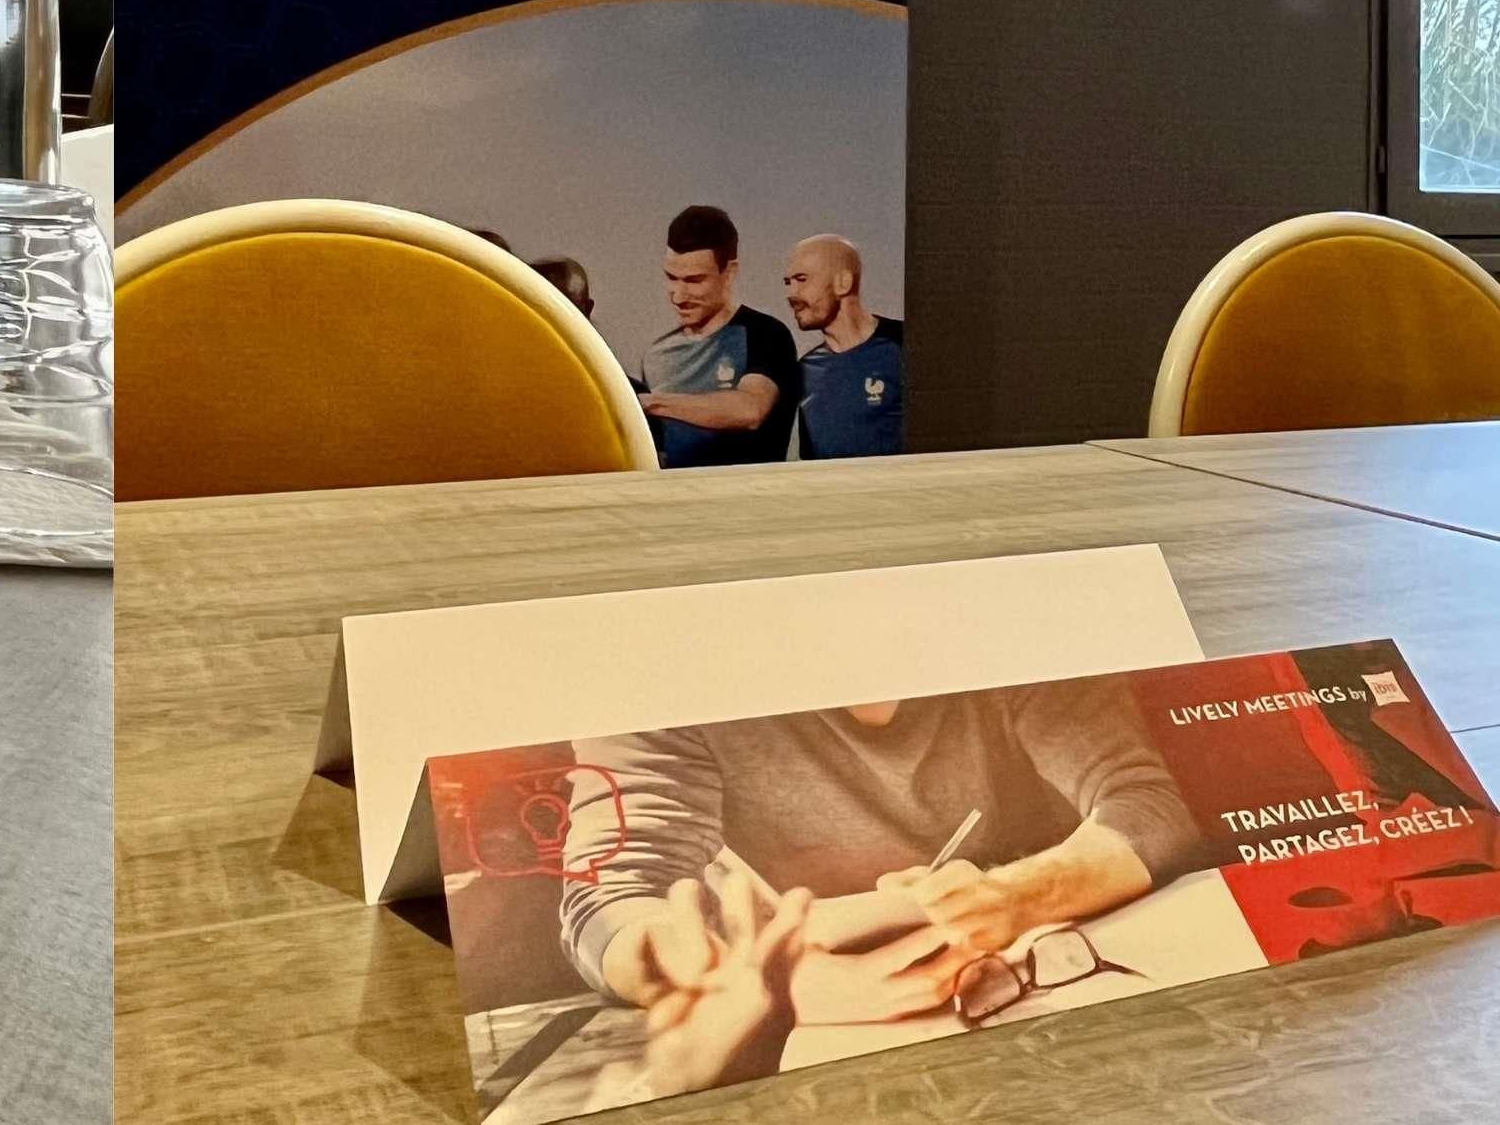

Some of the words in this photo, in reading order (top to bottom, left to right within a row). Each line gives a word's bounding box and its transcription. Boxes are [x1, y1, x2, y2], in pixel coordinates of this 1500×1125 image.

[1169, 701, 1240, 725] LIVELY
[1243, 686, 1348, 715] MEETINGS
[1349, 687, 1368, 702] by
[1220, 790, 1380, 833] TRAVAILLEZ,
[1237, 824, 1381, 867] PARTAGEZ,
